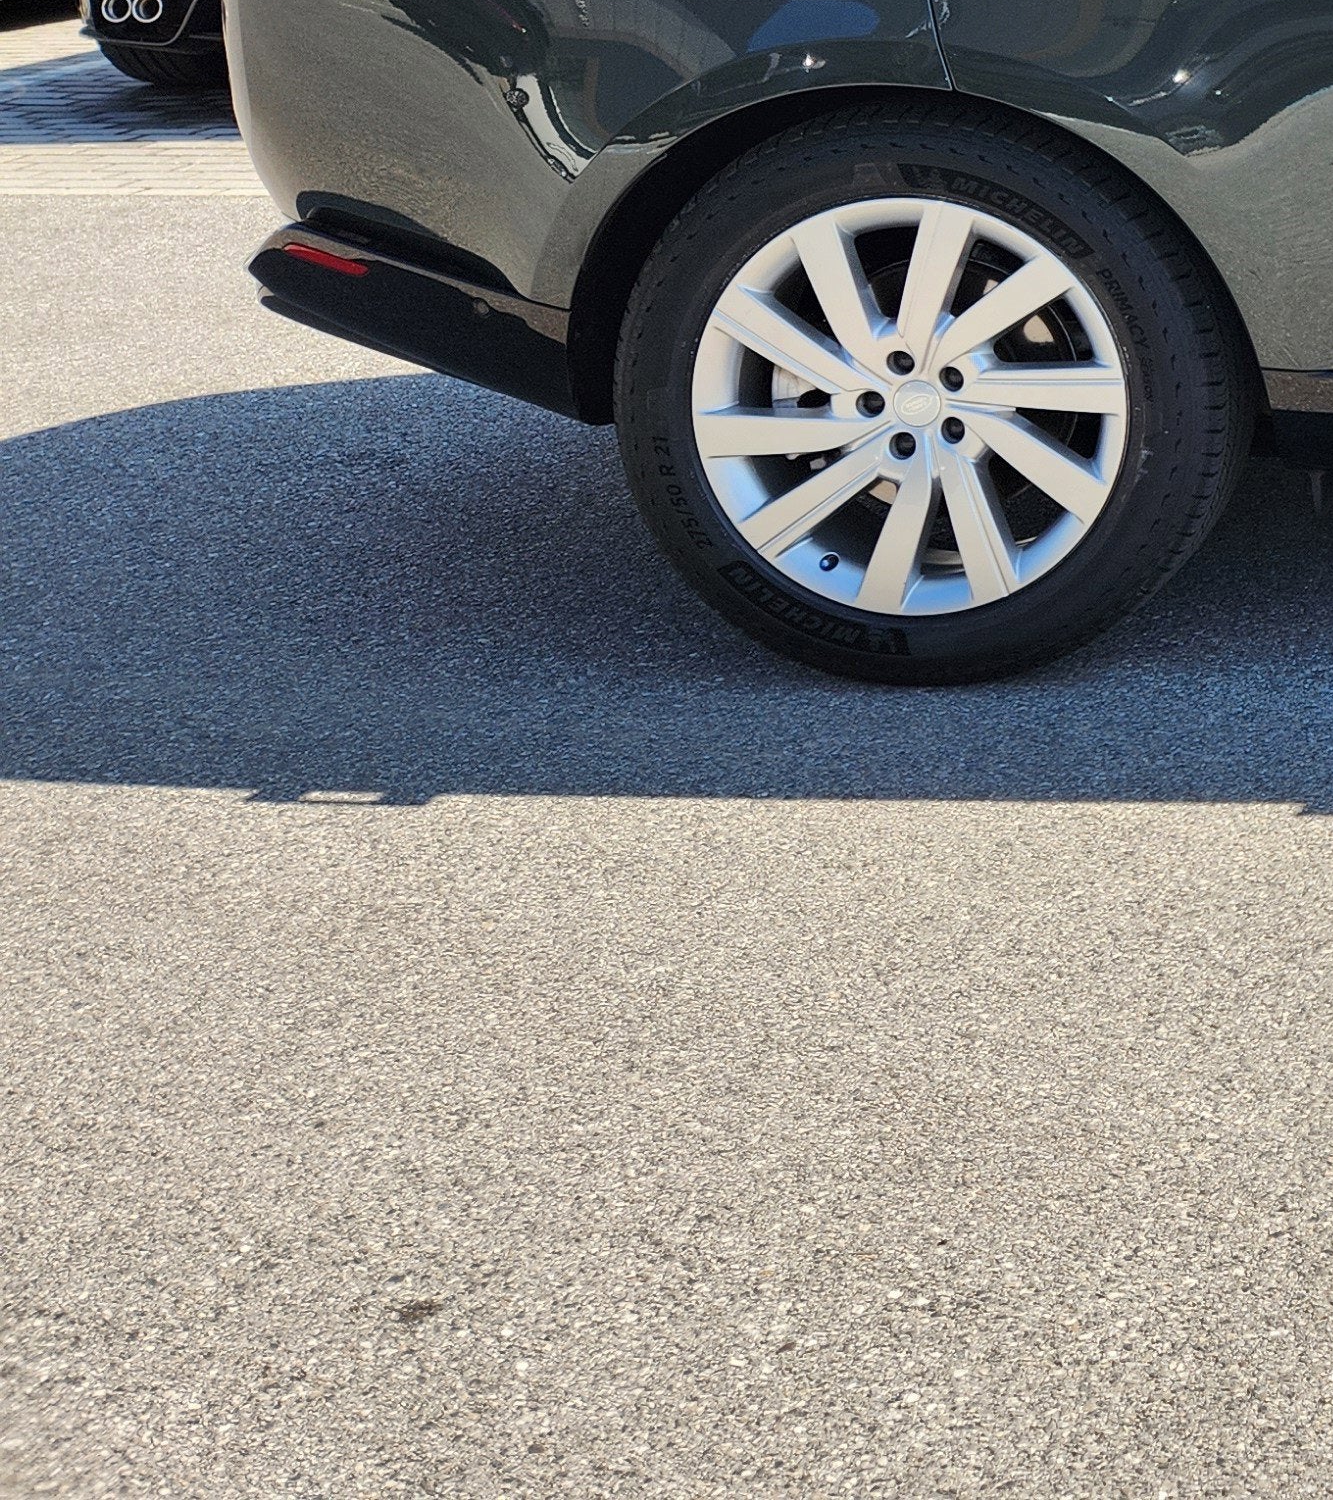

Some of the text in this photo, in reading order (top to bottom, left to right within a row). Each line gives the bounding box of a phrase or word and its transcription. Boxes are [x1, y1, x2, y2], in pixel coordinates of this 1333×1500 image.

[950, 176, 1085, 255] MICHELIN
[1095, 267, 1150, 350] PRIMACY
[665, 483, 714, 550] 275/50
[728, 566, 862, 642] MICHELIN
